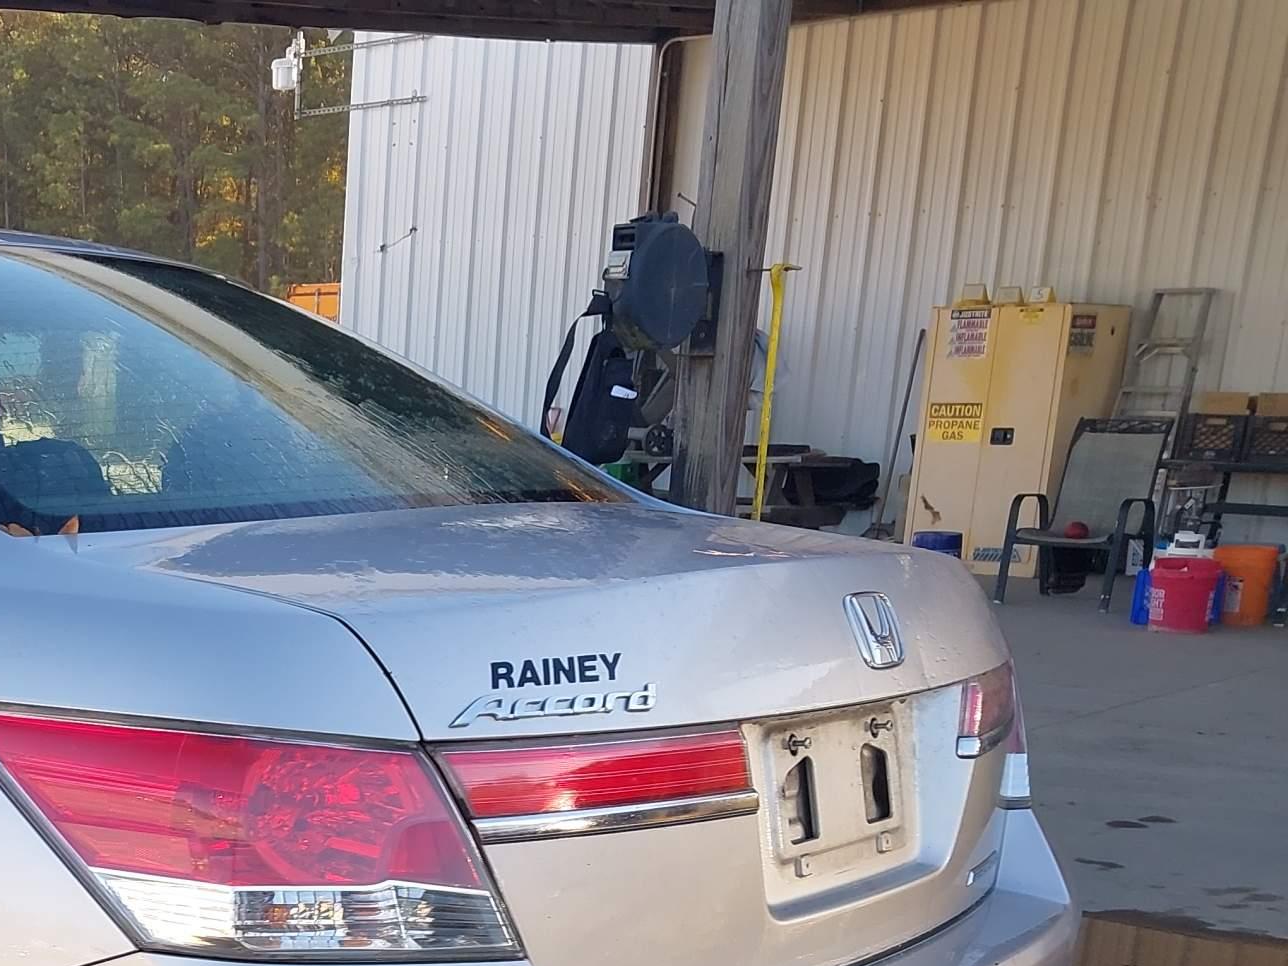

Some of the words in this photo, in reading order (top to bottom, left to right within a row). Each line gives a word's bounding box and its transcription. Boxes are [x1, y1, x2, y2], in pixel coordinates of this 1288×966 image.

[931, 404, 981, 417] CAUTION
[928, 420, 980, 430] PROPANE
[941, 430, 964, 440] GAS
[491, 653, 621, 689] RAINEY
[448, 683, 657, 728] Accord
